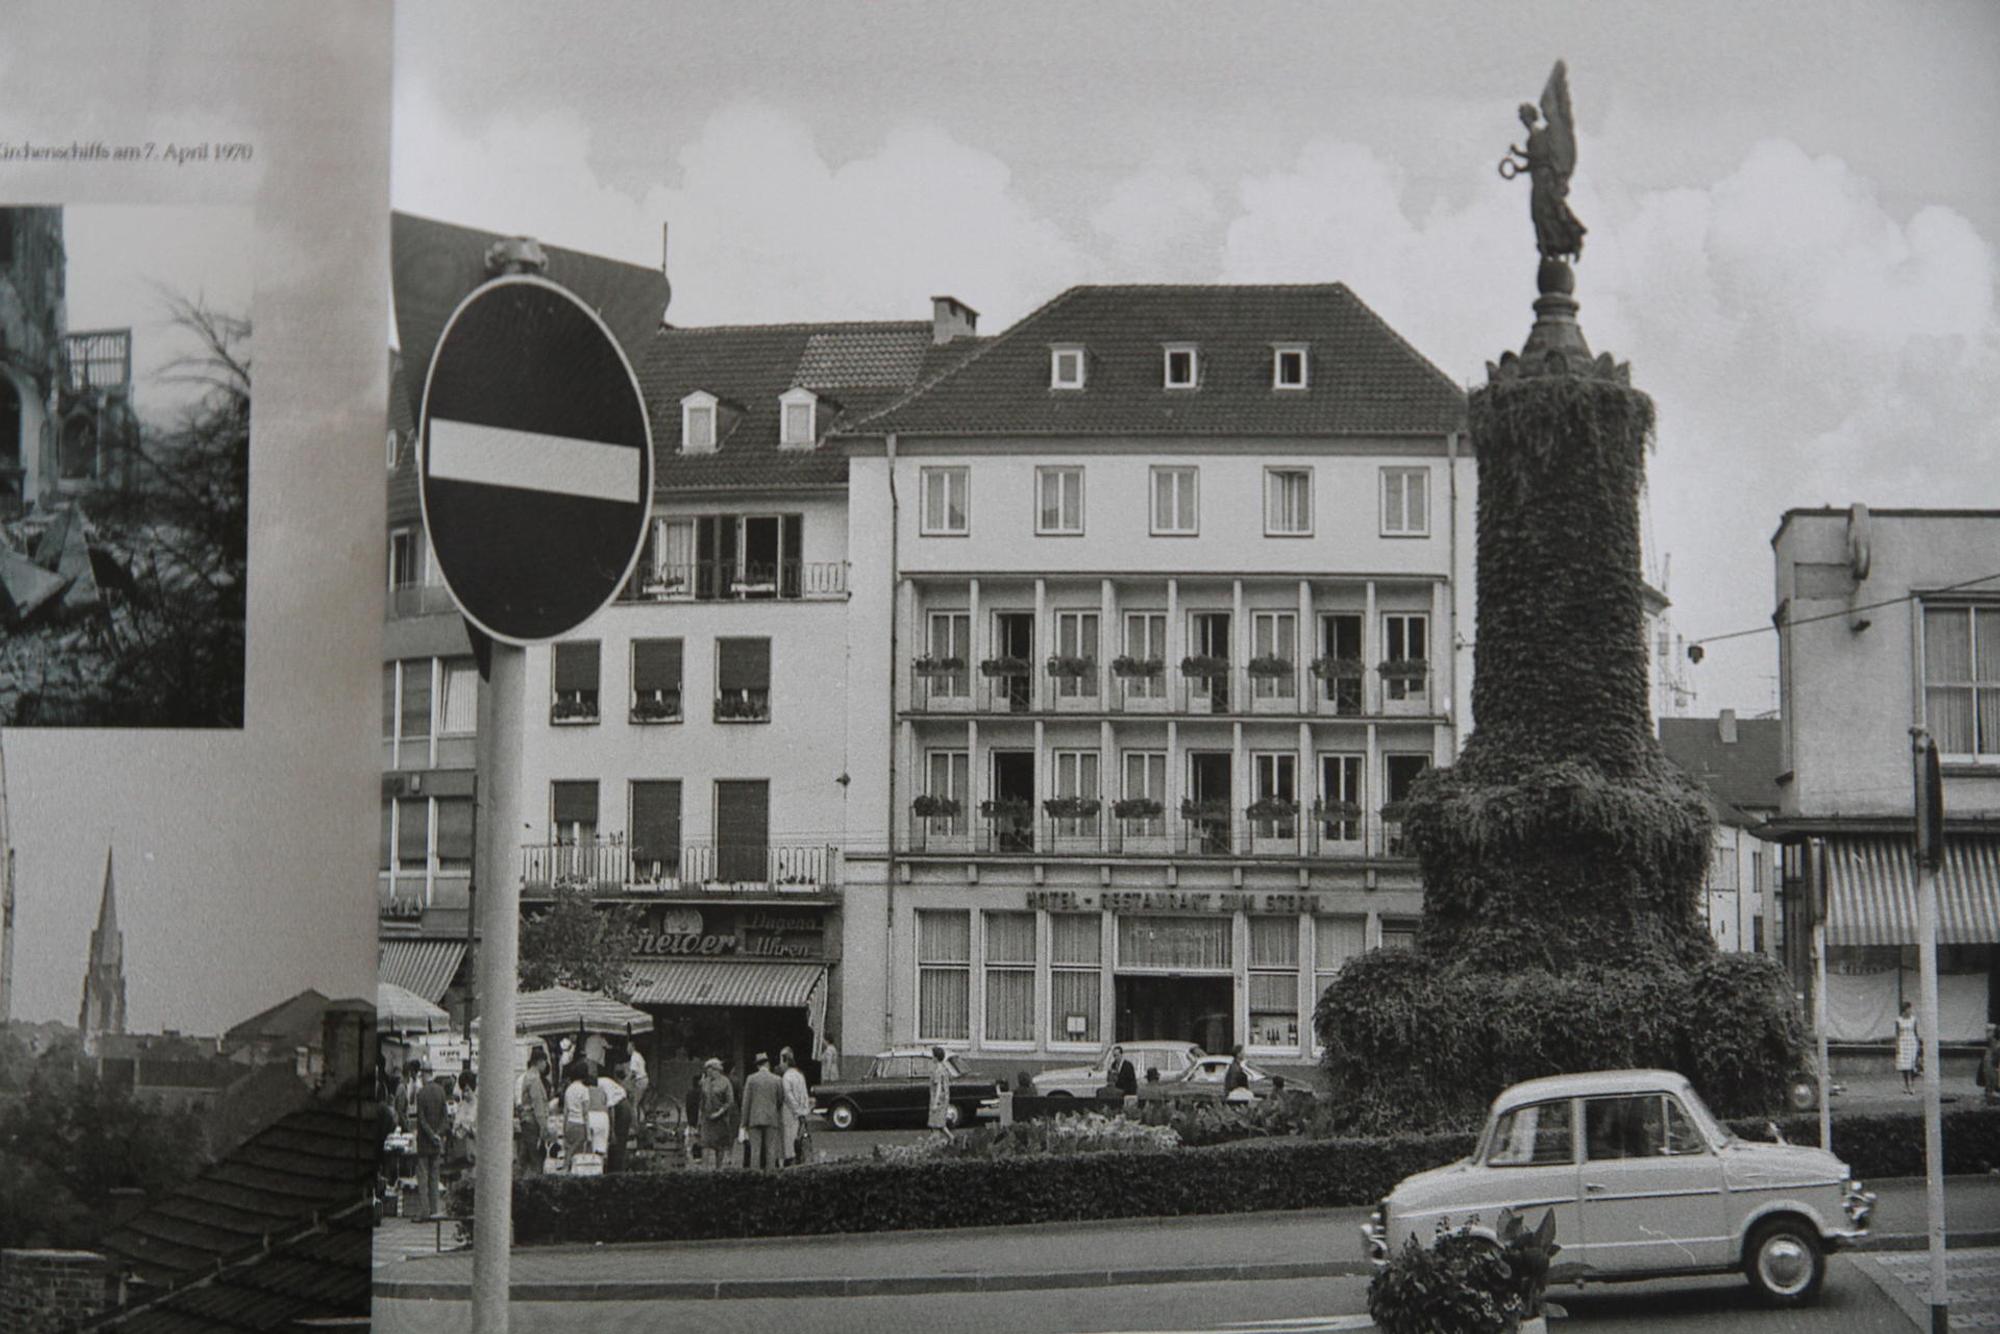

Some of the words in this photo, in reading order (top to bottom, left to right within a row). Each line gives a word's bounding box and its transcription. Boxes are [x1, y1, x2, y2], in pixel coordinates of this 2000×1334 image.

[113, 145, 141, 160] am
[144, 142, 159, 160] 7.
[162, 141, 209, 167] April
[214, 142, 254, 160] 1970
[1026, 891, 1079, 910] HOTEL
